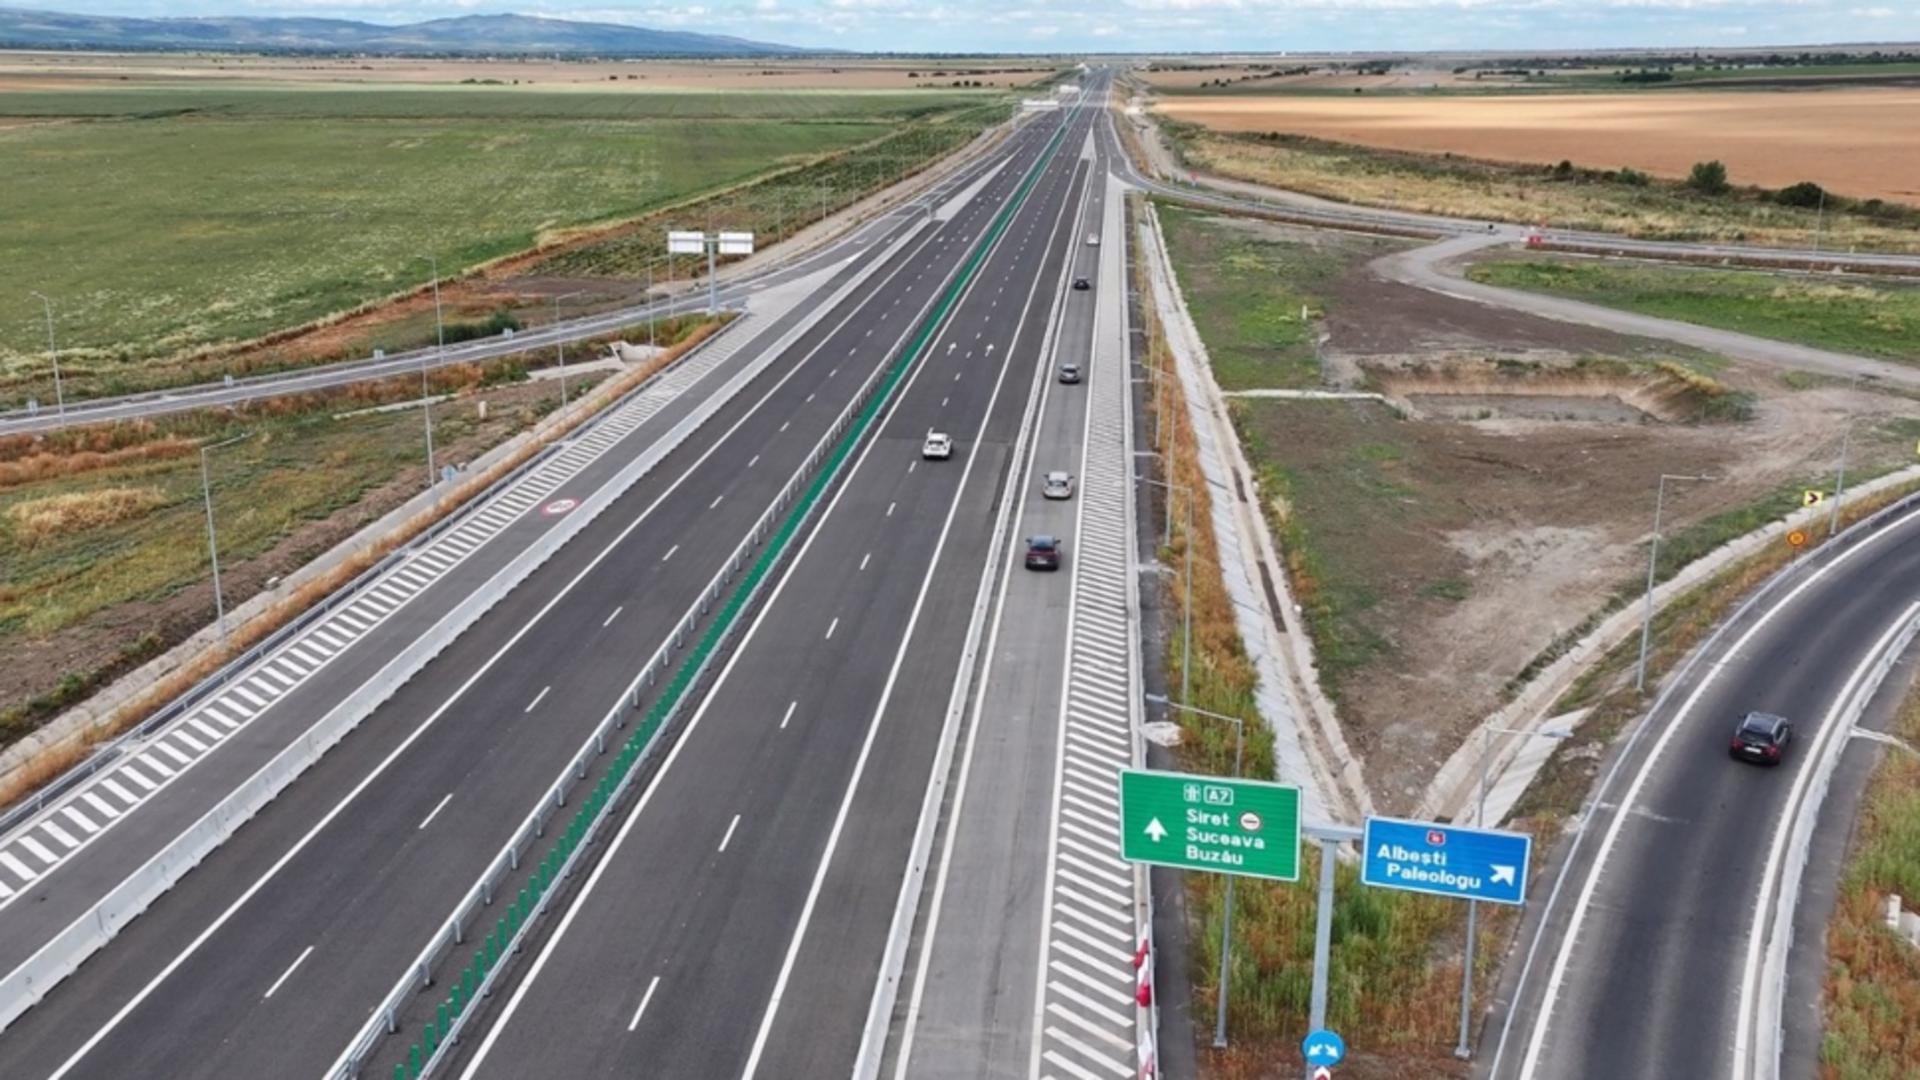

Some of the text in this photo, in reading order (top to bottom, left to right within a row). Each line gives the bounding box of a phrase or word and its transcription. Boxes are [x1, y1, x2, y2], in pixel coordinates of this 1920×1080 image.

[1208, 789, 1229, 802] A7
[1186, 808, 1230, 827] Siret
[1186, 826, 1265, 849] Suceava
[1387, 863, 1481, 890] Paleologu
